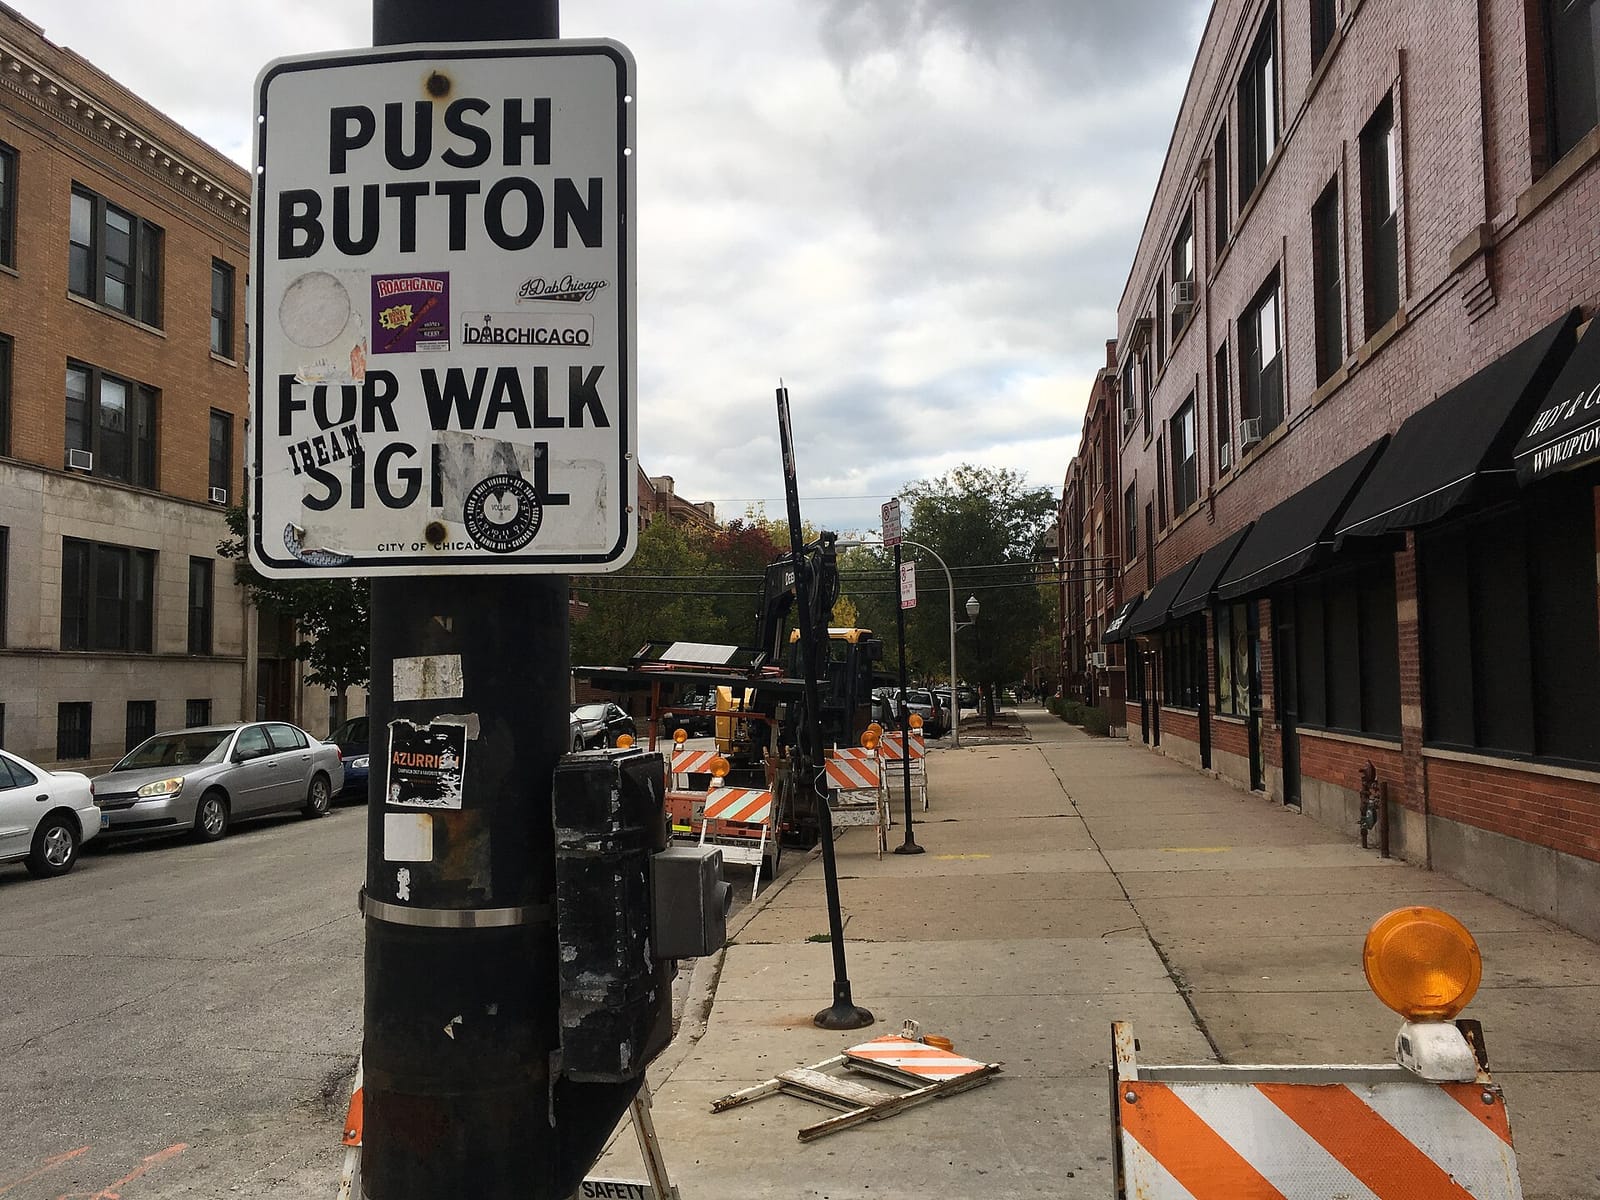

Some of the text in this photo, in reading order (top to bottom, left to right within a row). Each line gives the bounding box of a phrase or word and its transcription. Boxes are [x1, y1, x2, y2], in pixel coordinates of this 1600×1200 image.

[329, 97, 551, 175] PUSH
[277, 176, 603, 260] BUTTON
[278, 366, 611, 437] FOR WALK
[1526, 399, 1571, 438] HOT
[287, 423, 365, 476] IBEAM
[377, 542, 481, 552] CITY OF CHICA
[392, 751, 460, 769] AZURRI
[581, 1181, 644, 1200] SAFETY
